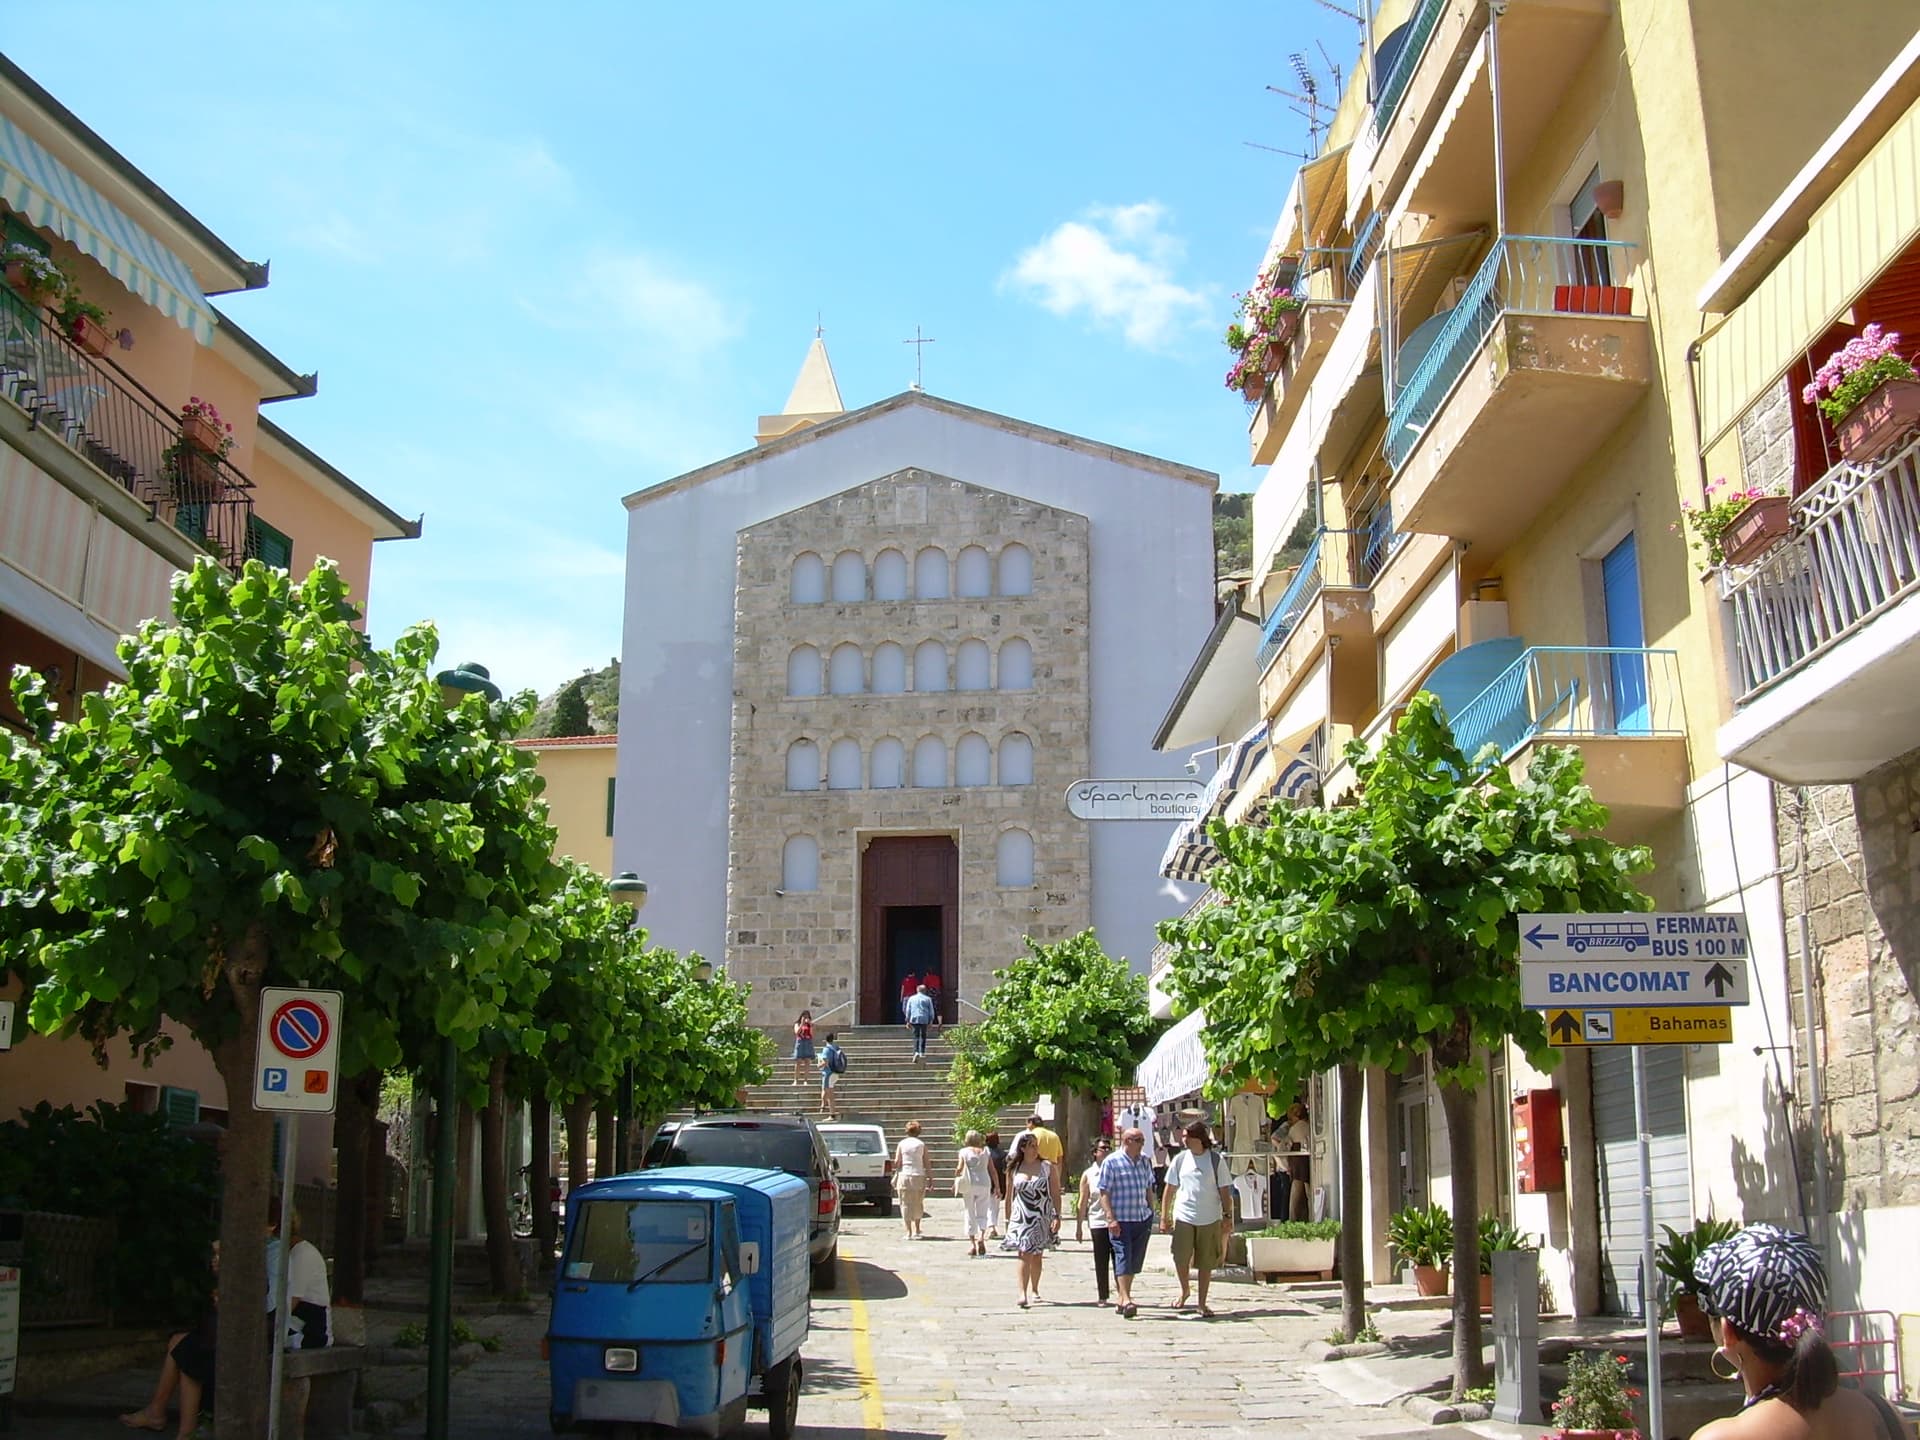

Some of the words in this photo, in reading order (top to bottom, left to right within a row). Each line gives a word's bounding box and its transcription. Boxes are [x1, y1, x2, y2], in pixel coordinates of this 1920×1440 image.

[1150, 803, 1198, 815] boutique
[1655, 916, 1739, 934] FERMATA
[1588, 936, 1624, 947] BRIZZI
[1652, 939, 1689, 957] BUS
[1695, 938, 1726, 956] 100
[1731, 937, 1746, 956] M
[1548, 971, 1691, 994] BANCOMAT
[1649, 1016, 1728, 1031] Bahamas
[267, 1070, 283, 1090] P
